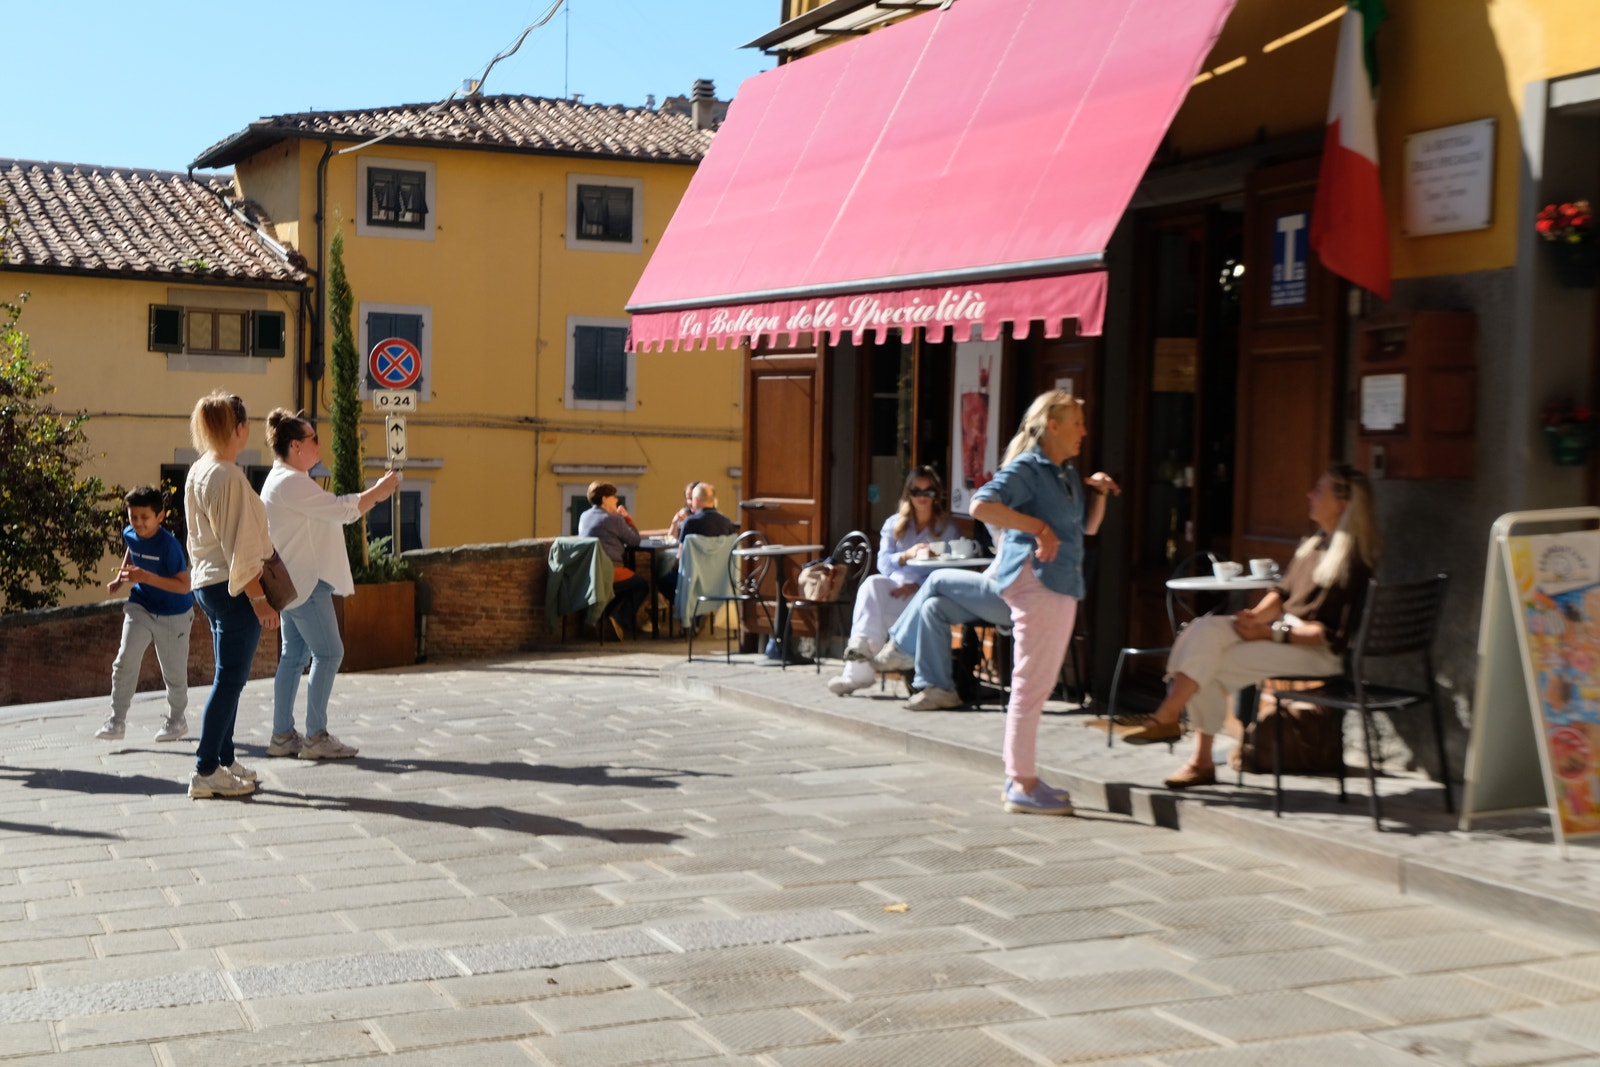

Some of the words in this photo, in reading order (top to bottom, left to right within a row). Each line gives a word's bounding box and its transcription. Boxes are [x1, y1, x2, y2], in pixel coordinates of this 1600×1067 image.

[679, 311, 703, 336] La
[786, 300, 838, 330] delle
[841, 290, 987, 336] Specialità
